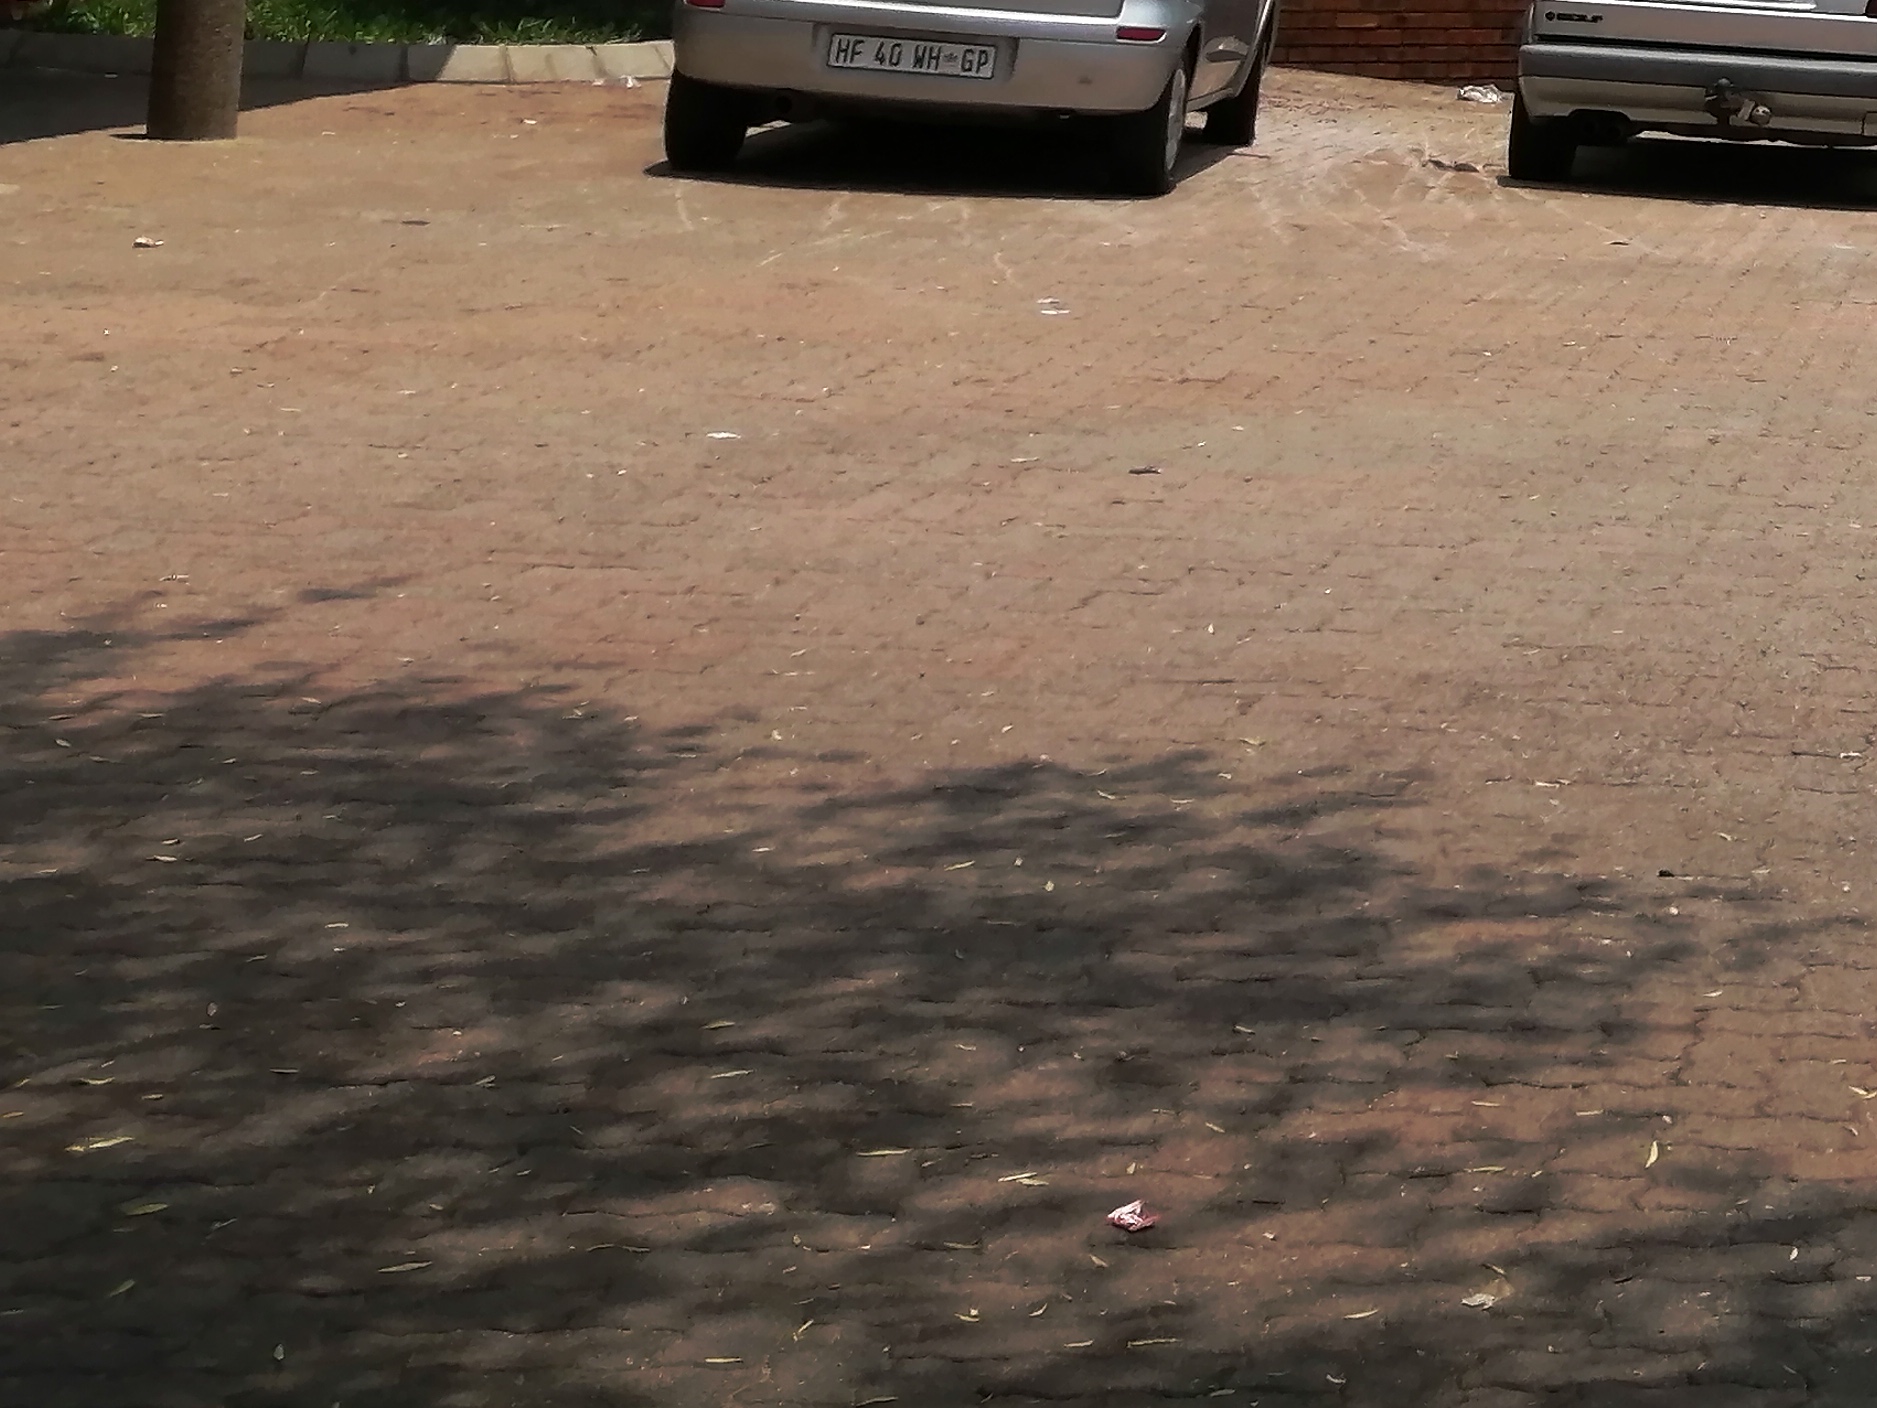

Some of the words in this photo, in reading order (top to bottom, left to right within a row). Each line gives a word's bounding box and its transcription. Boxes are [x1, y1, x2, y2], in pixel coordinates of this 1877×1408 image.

[835, 38, 865, 64] HF
[874, 41, 903, 67] 40
[912, 44, 943, 71] WH
[961, 48, 990, 74] GP
